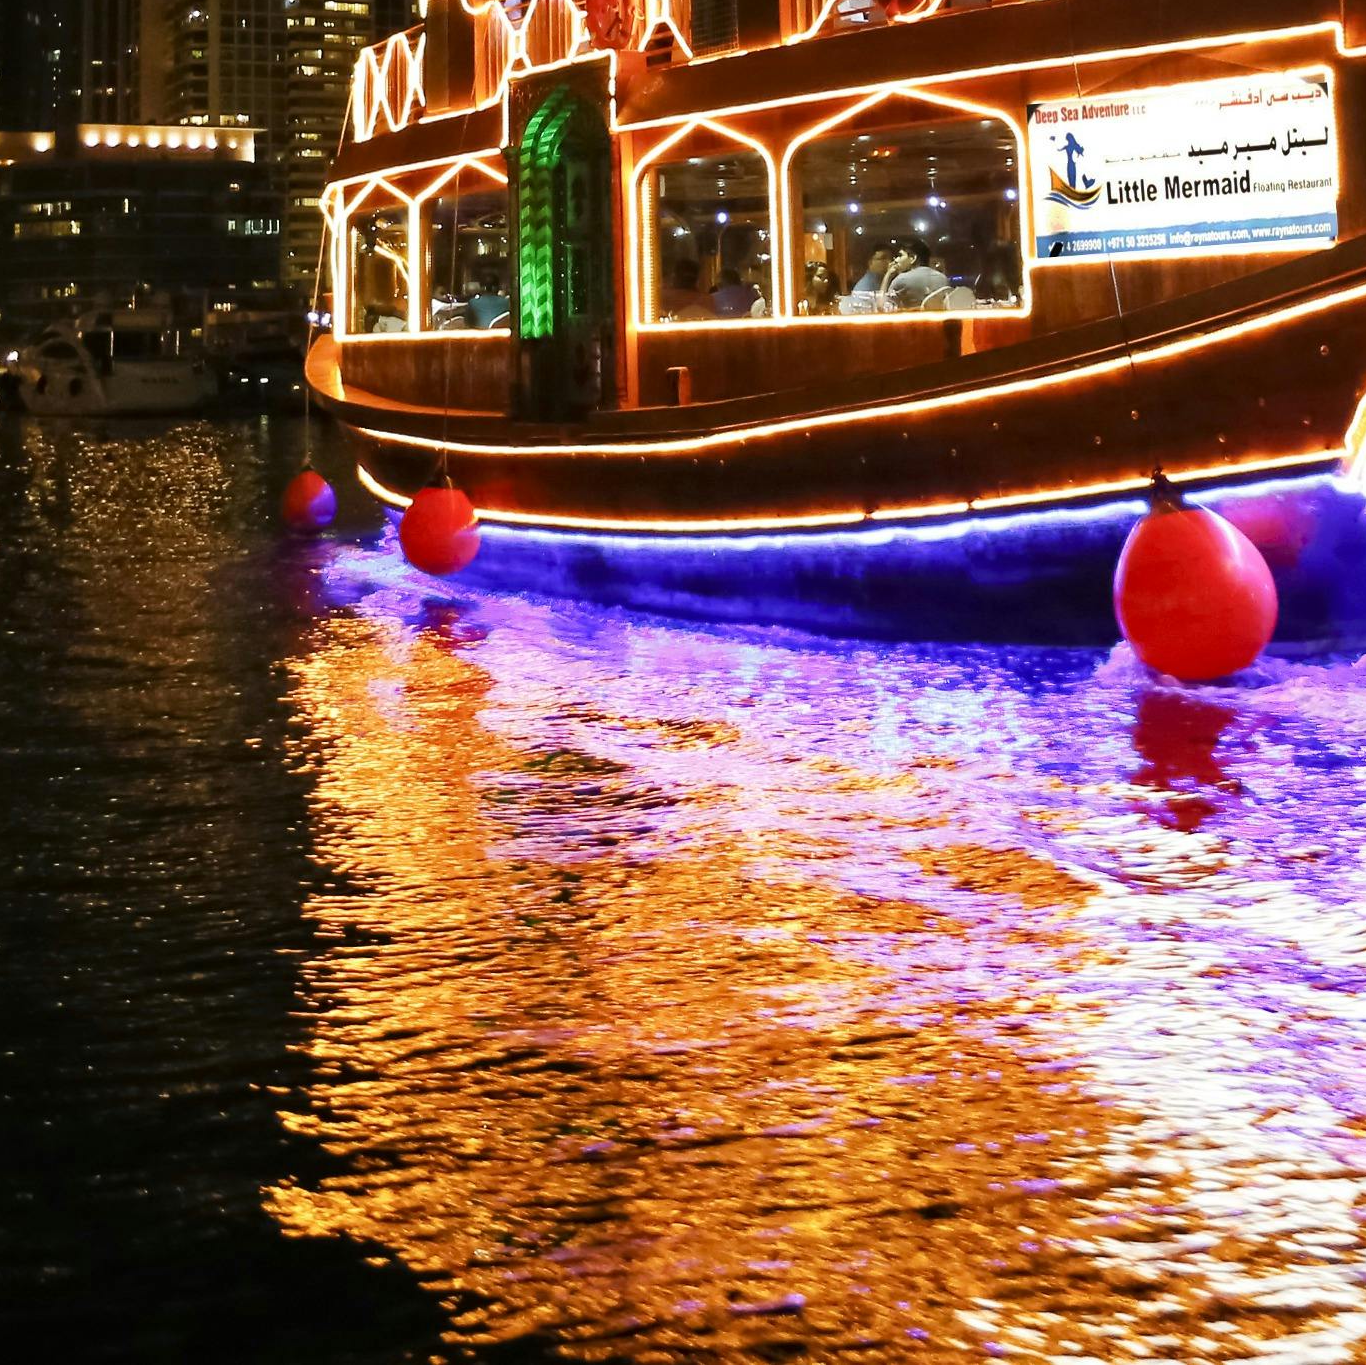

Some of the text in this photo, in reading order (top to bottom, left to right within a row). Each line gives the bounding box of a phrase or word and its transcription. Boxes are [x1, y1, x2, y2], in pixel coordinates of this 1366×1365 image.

[1035, 109, 1059, 124] Deep
[1061, 106, 1079, 122] Sea
[1082, 103, 1130, 120] Adventure
[1106, 169, 1332, 205] Little Mermaid Floating Restaurant
[1251, 222, 1332, 239] www.raynatours.com
